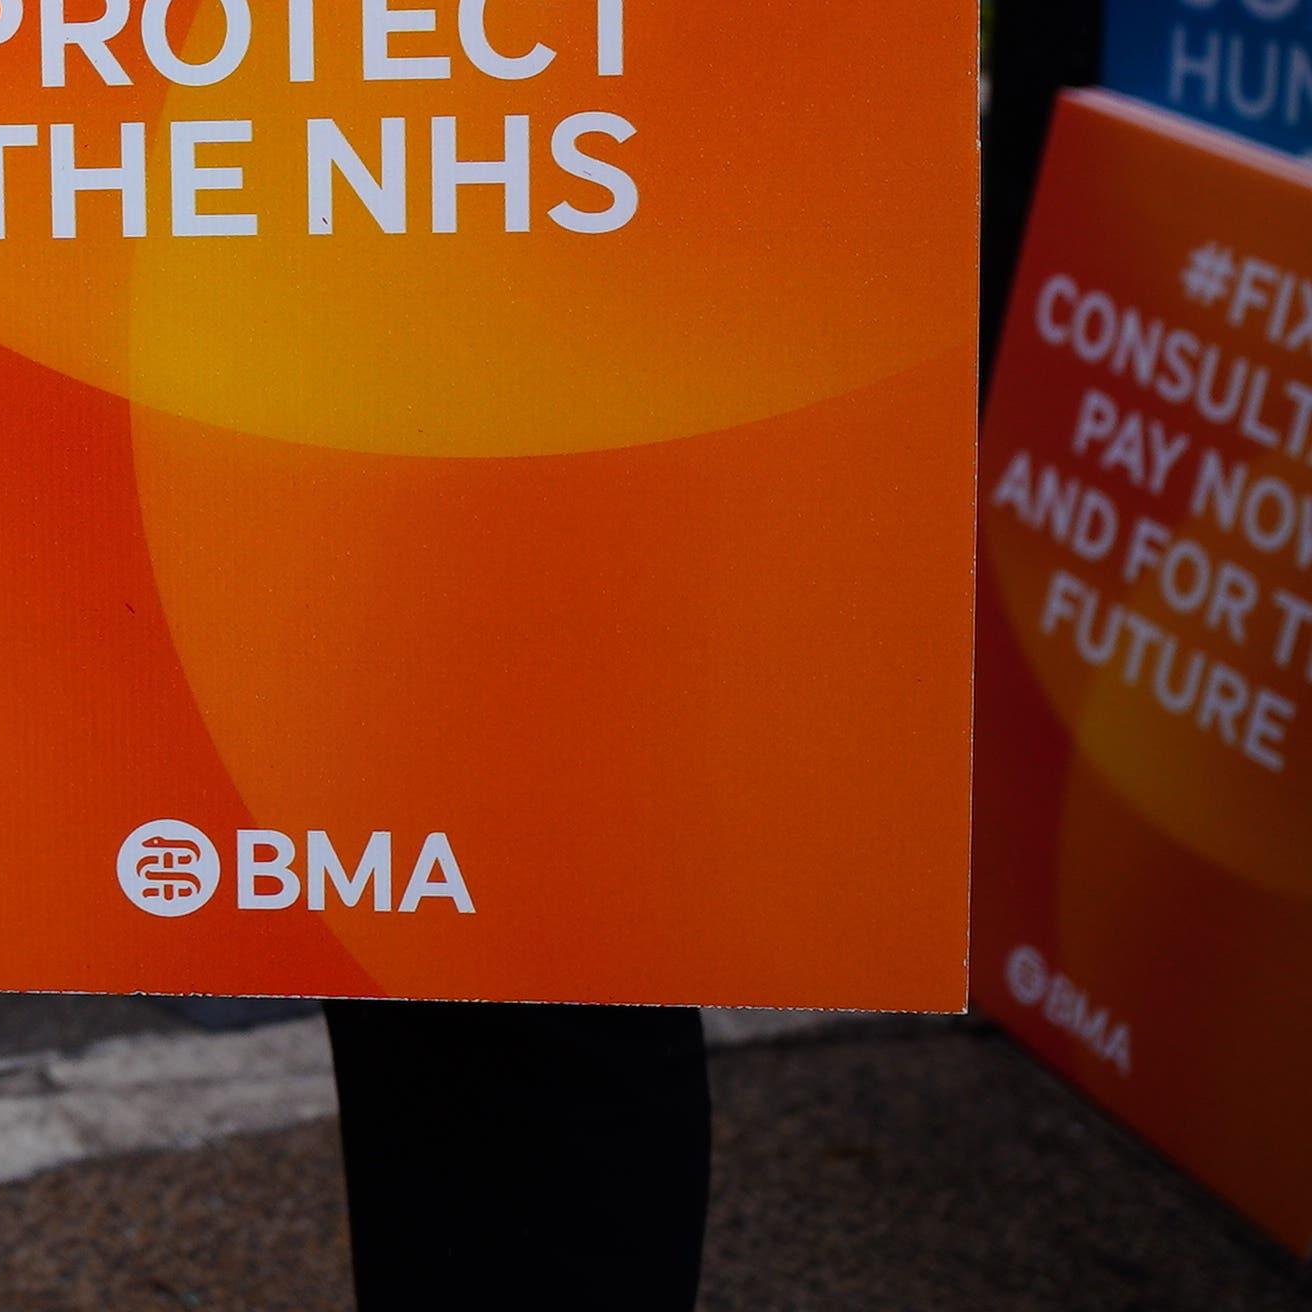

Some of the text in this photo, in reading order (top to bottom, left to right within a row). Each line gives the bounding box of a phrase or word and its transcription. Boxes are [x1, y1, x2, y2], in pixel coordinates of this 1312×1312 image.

[307, 111, 638, 235] NHS
[1035, 273, 1312, 464] CONSULT
[1071, 386, 1189, 496] PAY
[992, 452, 1118, 563] AND
[1123, 517, 1260, 644] FOR
[1040, 569, 1296, 772] FUTURE
[237, 829, 475, 913] BMA
[1045, 973, 1131, 1078] BMA
